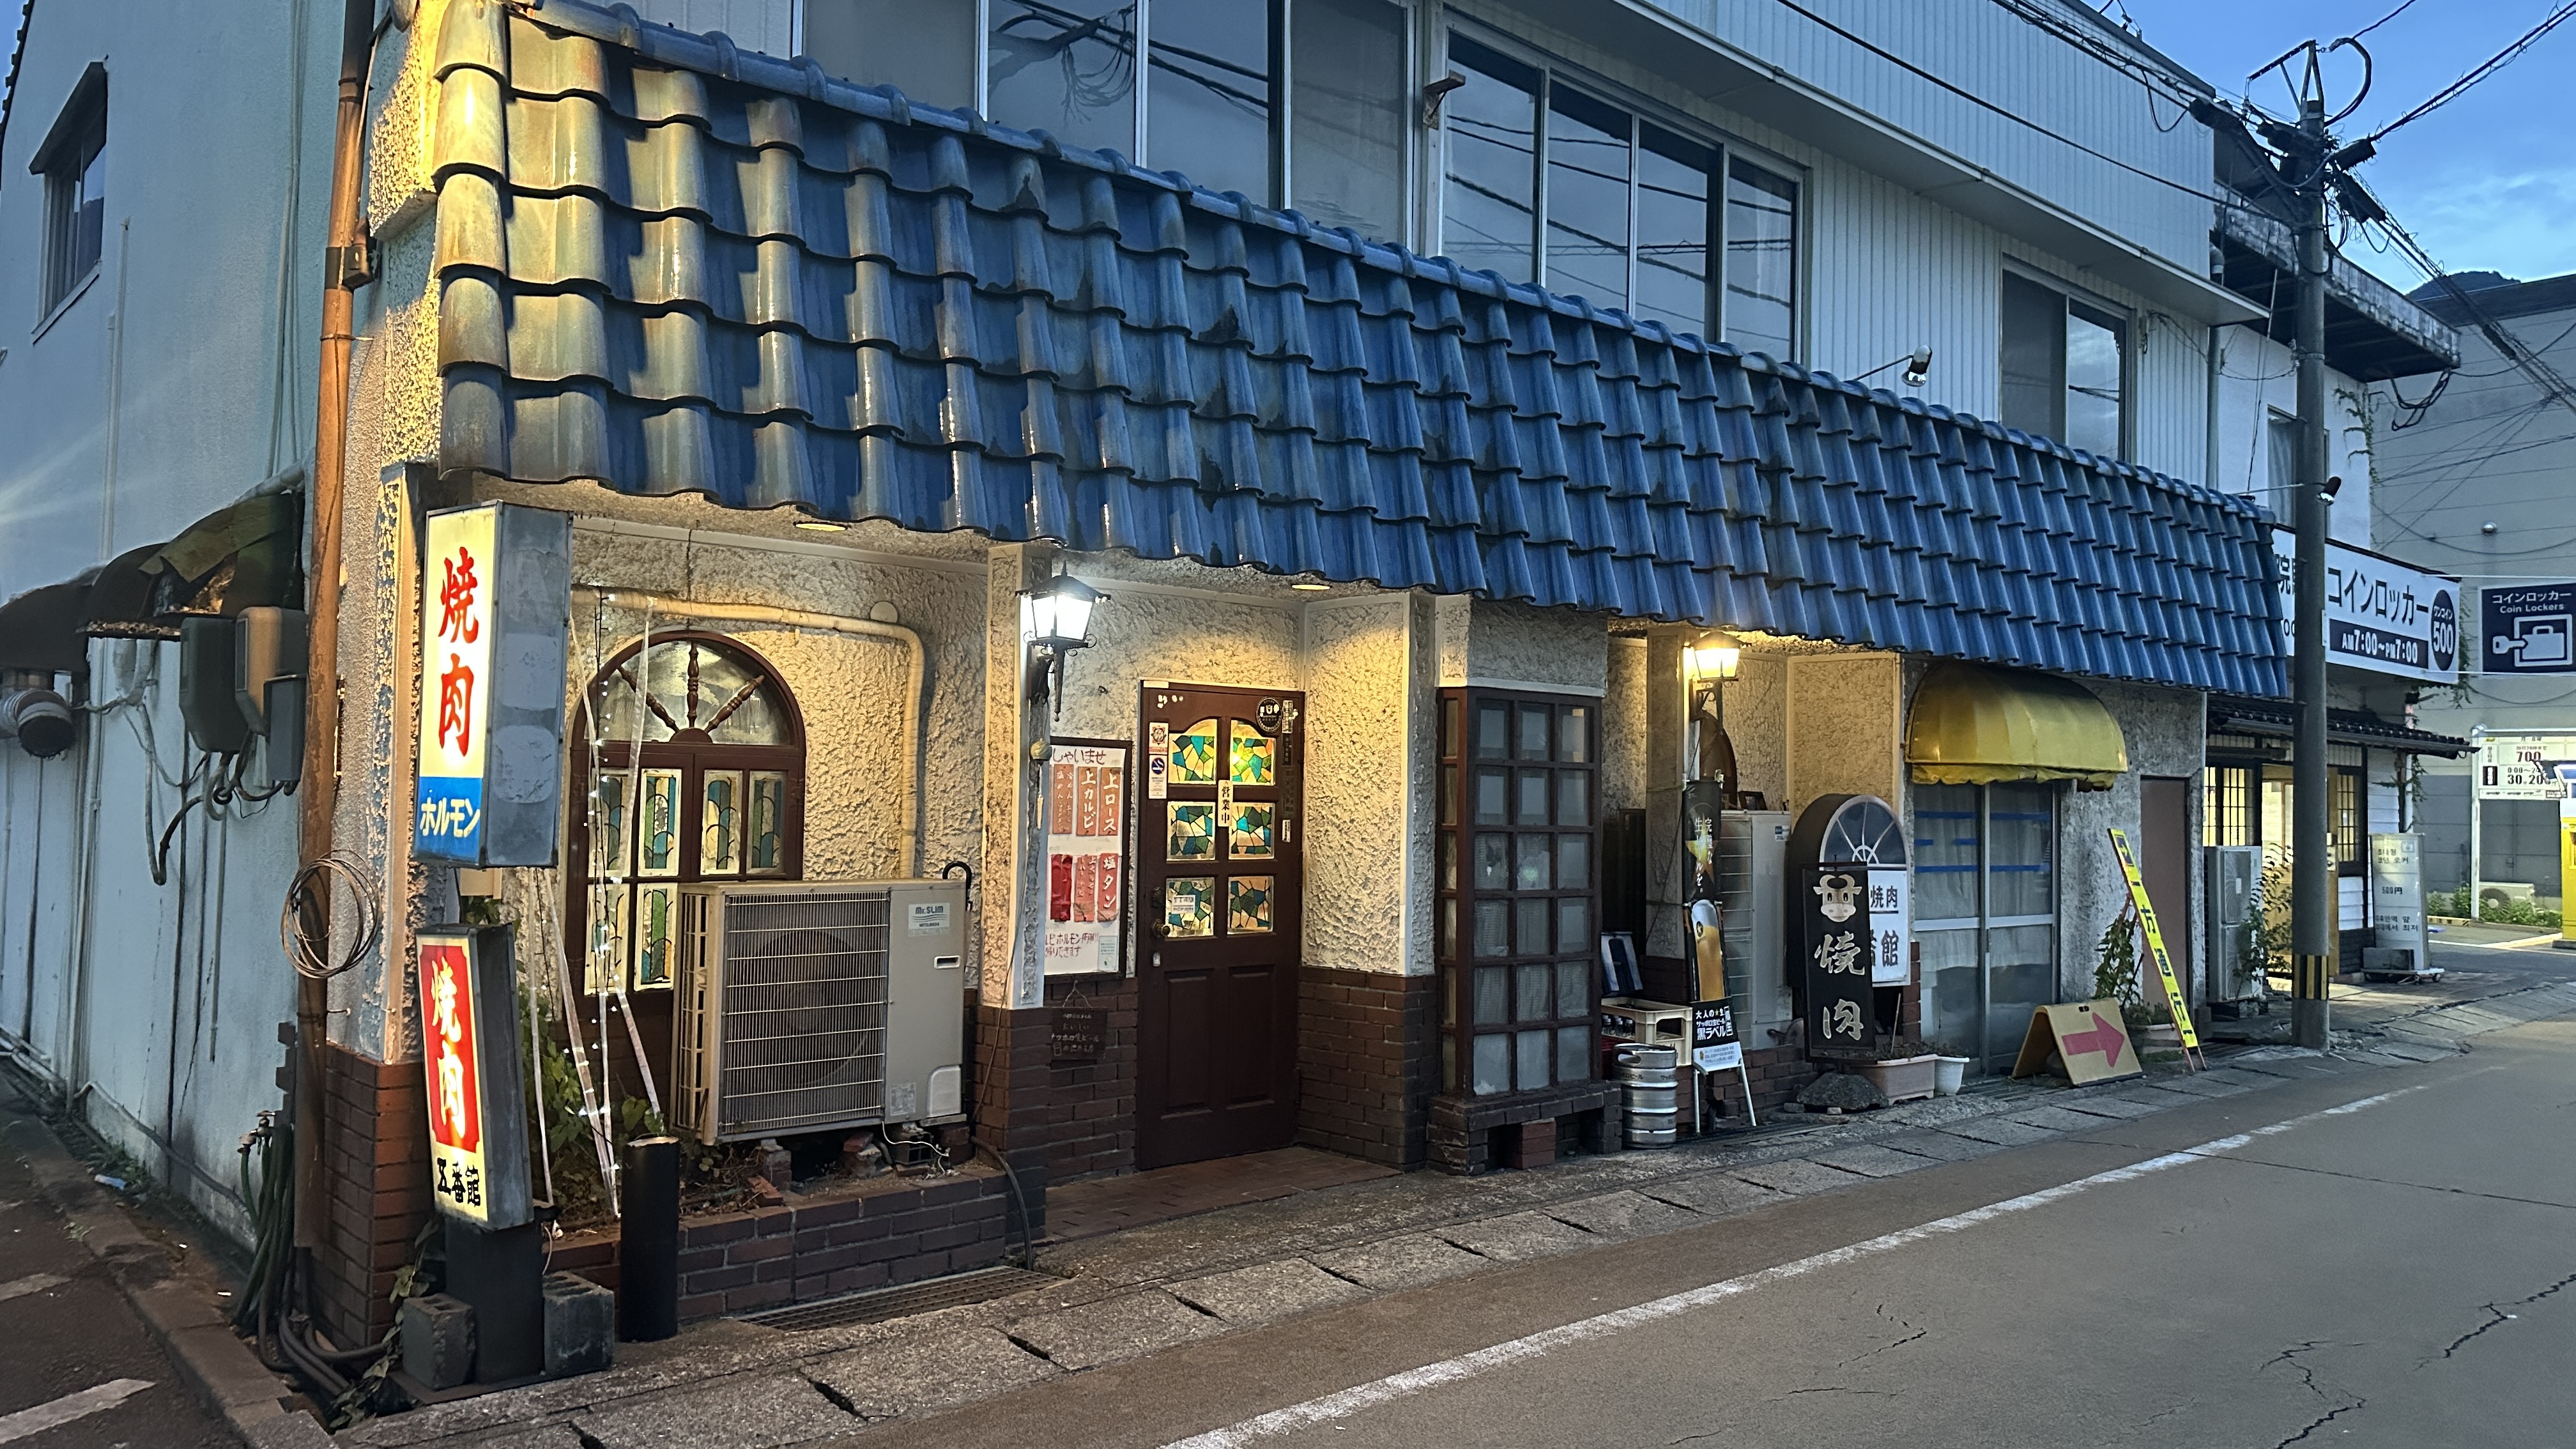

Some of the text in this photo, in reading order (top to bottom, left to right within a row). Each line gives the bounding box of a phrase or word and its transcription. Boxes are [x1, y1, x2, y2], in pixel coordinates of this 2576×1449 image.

[2328, 567, 2428, 626] コインロッカー
[2492, 590, 2572, 604] コインロッカー
[2499, 602, 2565, 613] Coin Lockers
[437, 546, 480, 757] 焼肉
[2433, 621, 2454, 655] 500
[2516, 751, 2542, 762] 700
[419, 797, 480, 838] ホルモン
[1080, 770, 1097, 829] 上カルビ
[1103, 772, 1119, 831] 上ロース
[1221, 786, 1230, 824] 営業中
[1103, 855, 1116, 908] 塩タン
[1870, 885, 1897, 908] 焼肉
[431, 955, 465, 1138] 焼肉
[1697, 1025, 1726, 1041] 黒ラベル
[437, 1157, 481, 1208] 五番館
